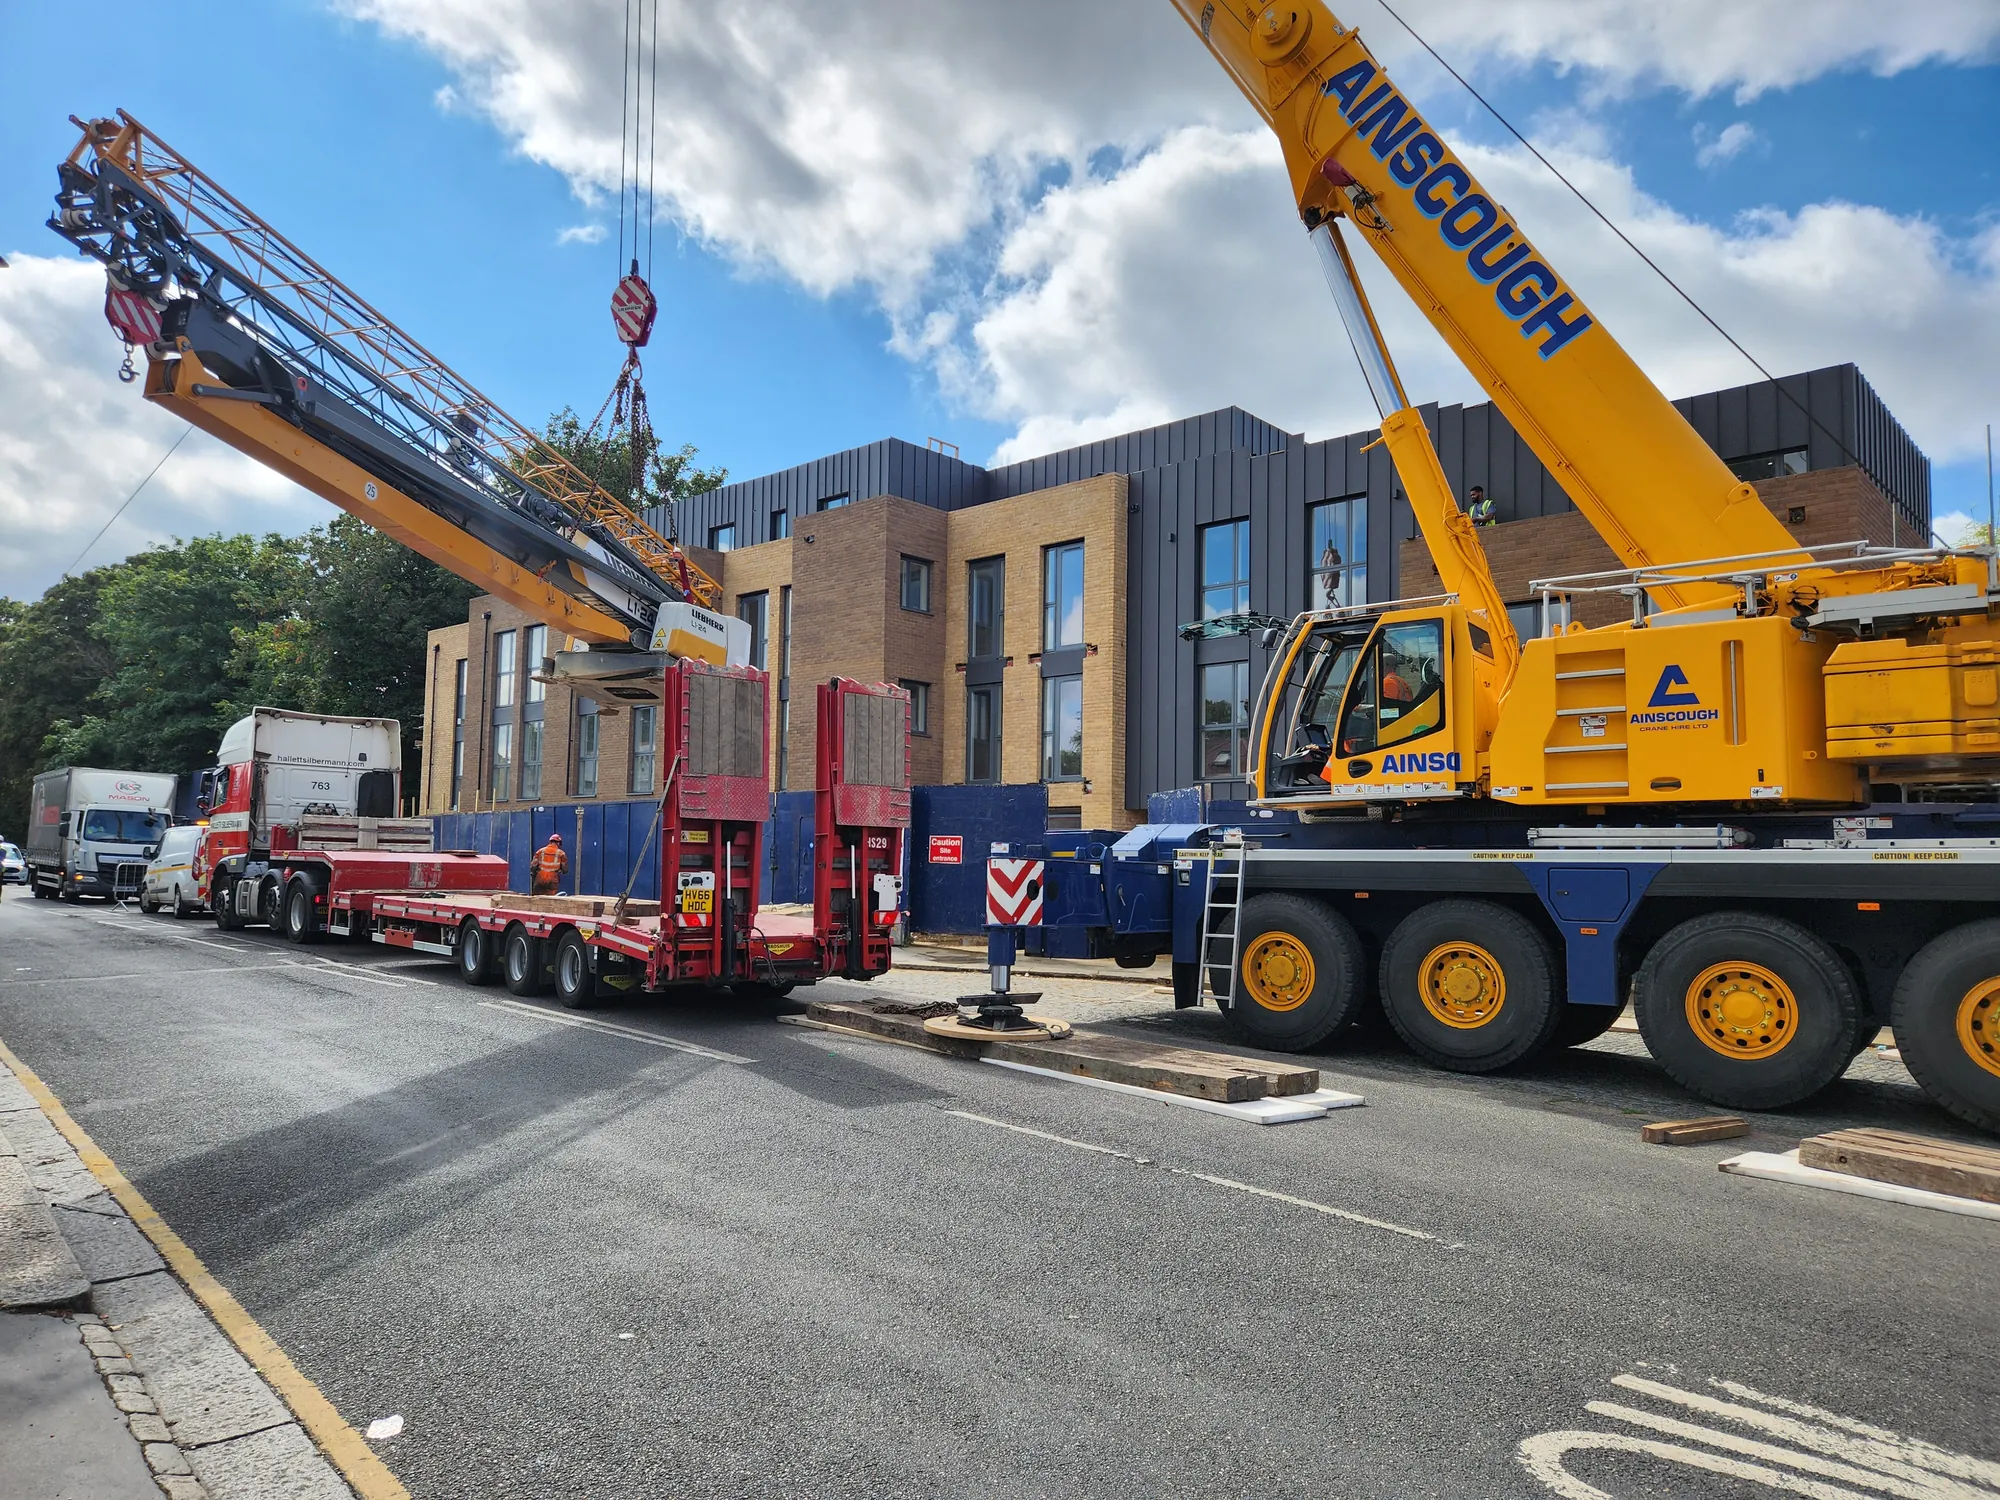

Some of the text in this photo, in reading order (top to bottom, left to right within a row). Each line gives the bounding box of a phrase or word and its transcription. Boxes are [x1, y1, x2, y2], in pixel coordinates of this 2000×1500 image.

[1321, 59, 1594, 362] AINSCOUGH
[366, 483, 376, 498] 25
[691, 608, 724, 633] LIEBHERR
[1630, 709, 1719, 724] AINSCOUGH
[277, 755, 365, 768] hallettsilbermann.com
[311, 781, 330, 791] 763
[108, 794, 150, 802] MASON
[931, 838, 961, 846] Caution
[1873, 852, 1959, 860] CAUTION! KEEP CLEAR
[685, 890, 710, 900] HV66
[687, 901, 707, 911] HDC
